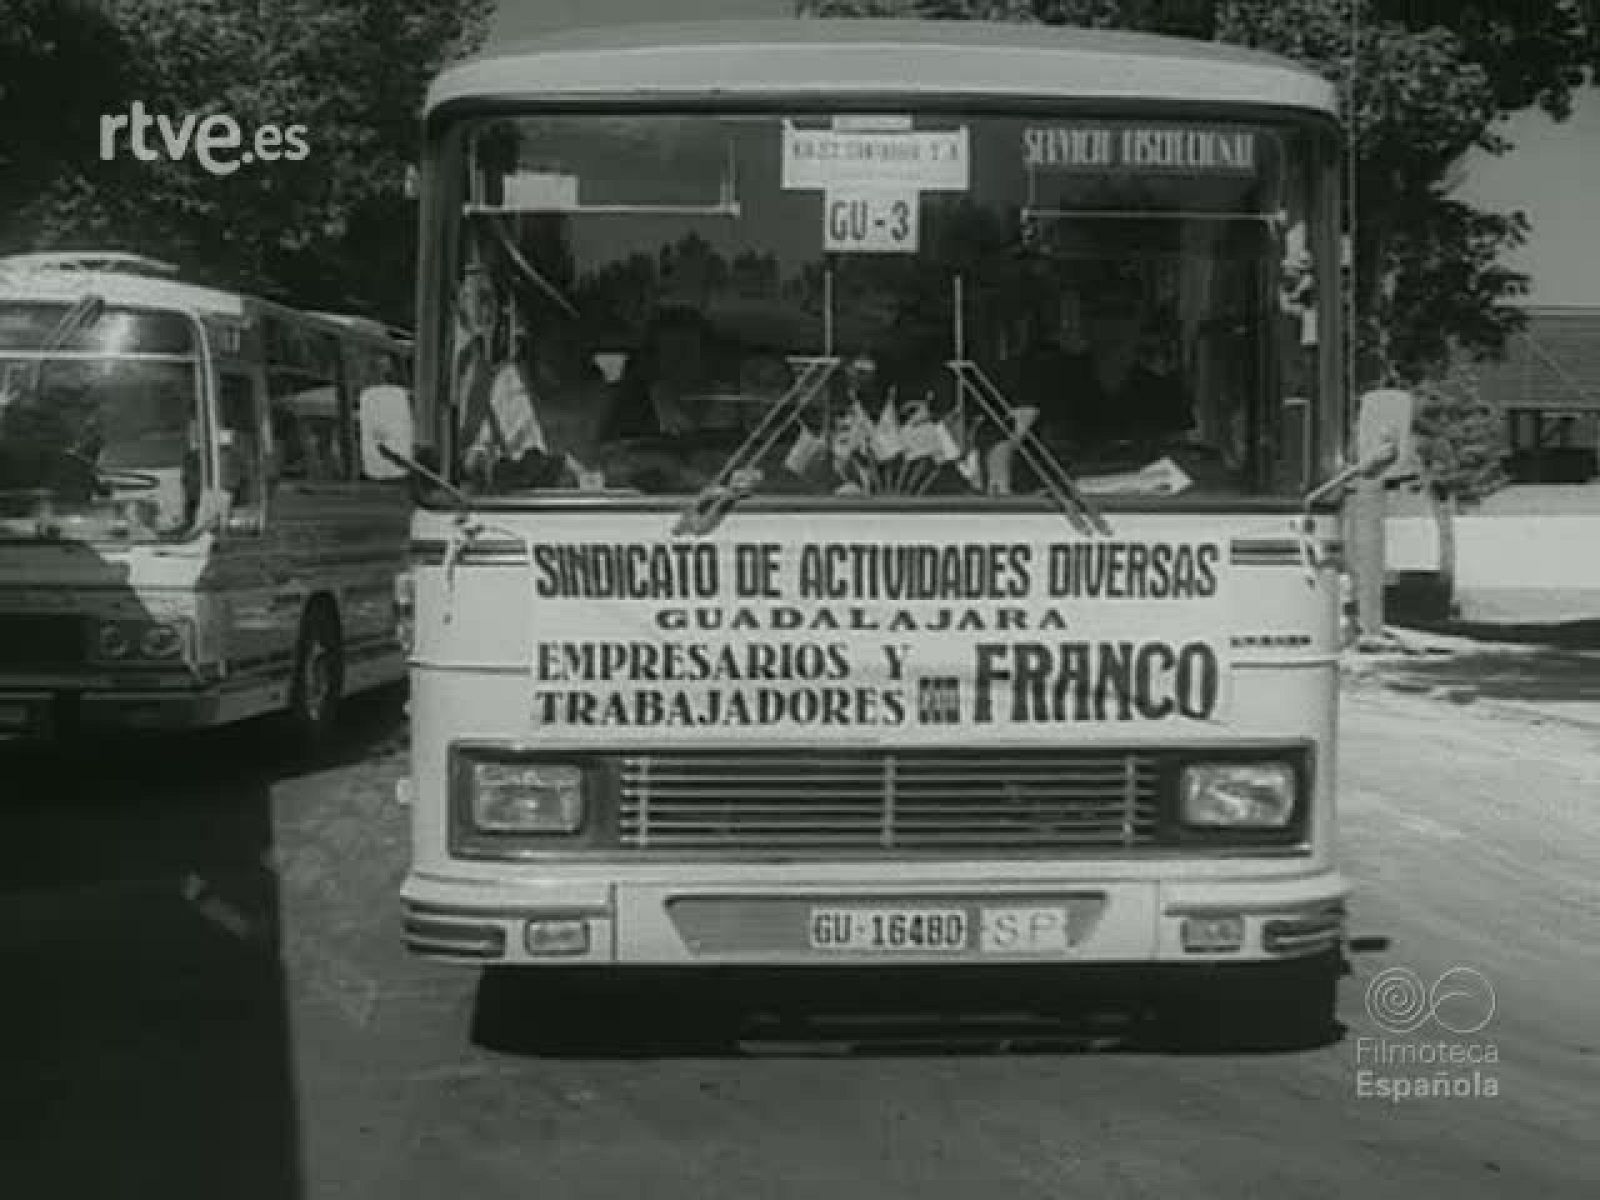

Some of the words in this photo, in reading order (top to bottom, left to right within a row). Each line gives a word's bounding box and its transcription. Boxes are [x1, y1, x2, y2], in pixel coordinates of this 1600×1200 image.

[830, 200, 911, 241] GU-3
[534, 542, 718, 598] SINDICATO
[735, 542, 783, 598] DE
[799, 542, 1031, 598] ACTIVIDADES
[1049, 542, 1219, 598] DIVERSAS
[655, 608, 1067, 631] GUADALAJARA
[536, 643, 850, 681] EMPRESARIOS
[880, 643, 909, 681] Y
[973, 642, 1219, 724] FRANCO
[535, 688, 906, 726] TRABAJADORES
